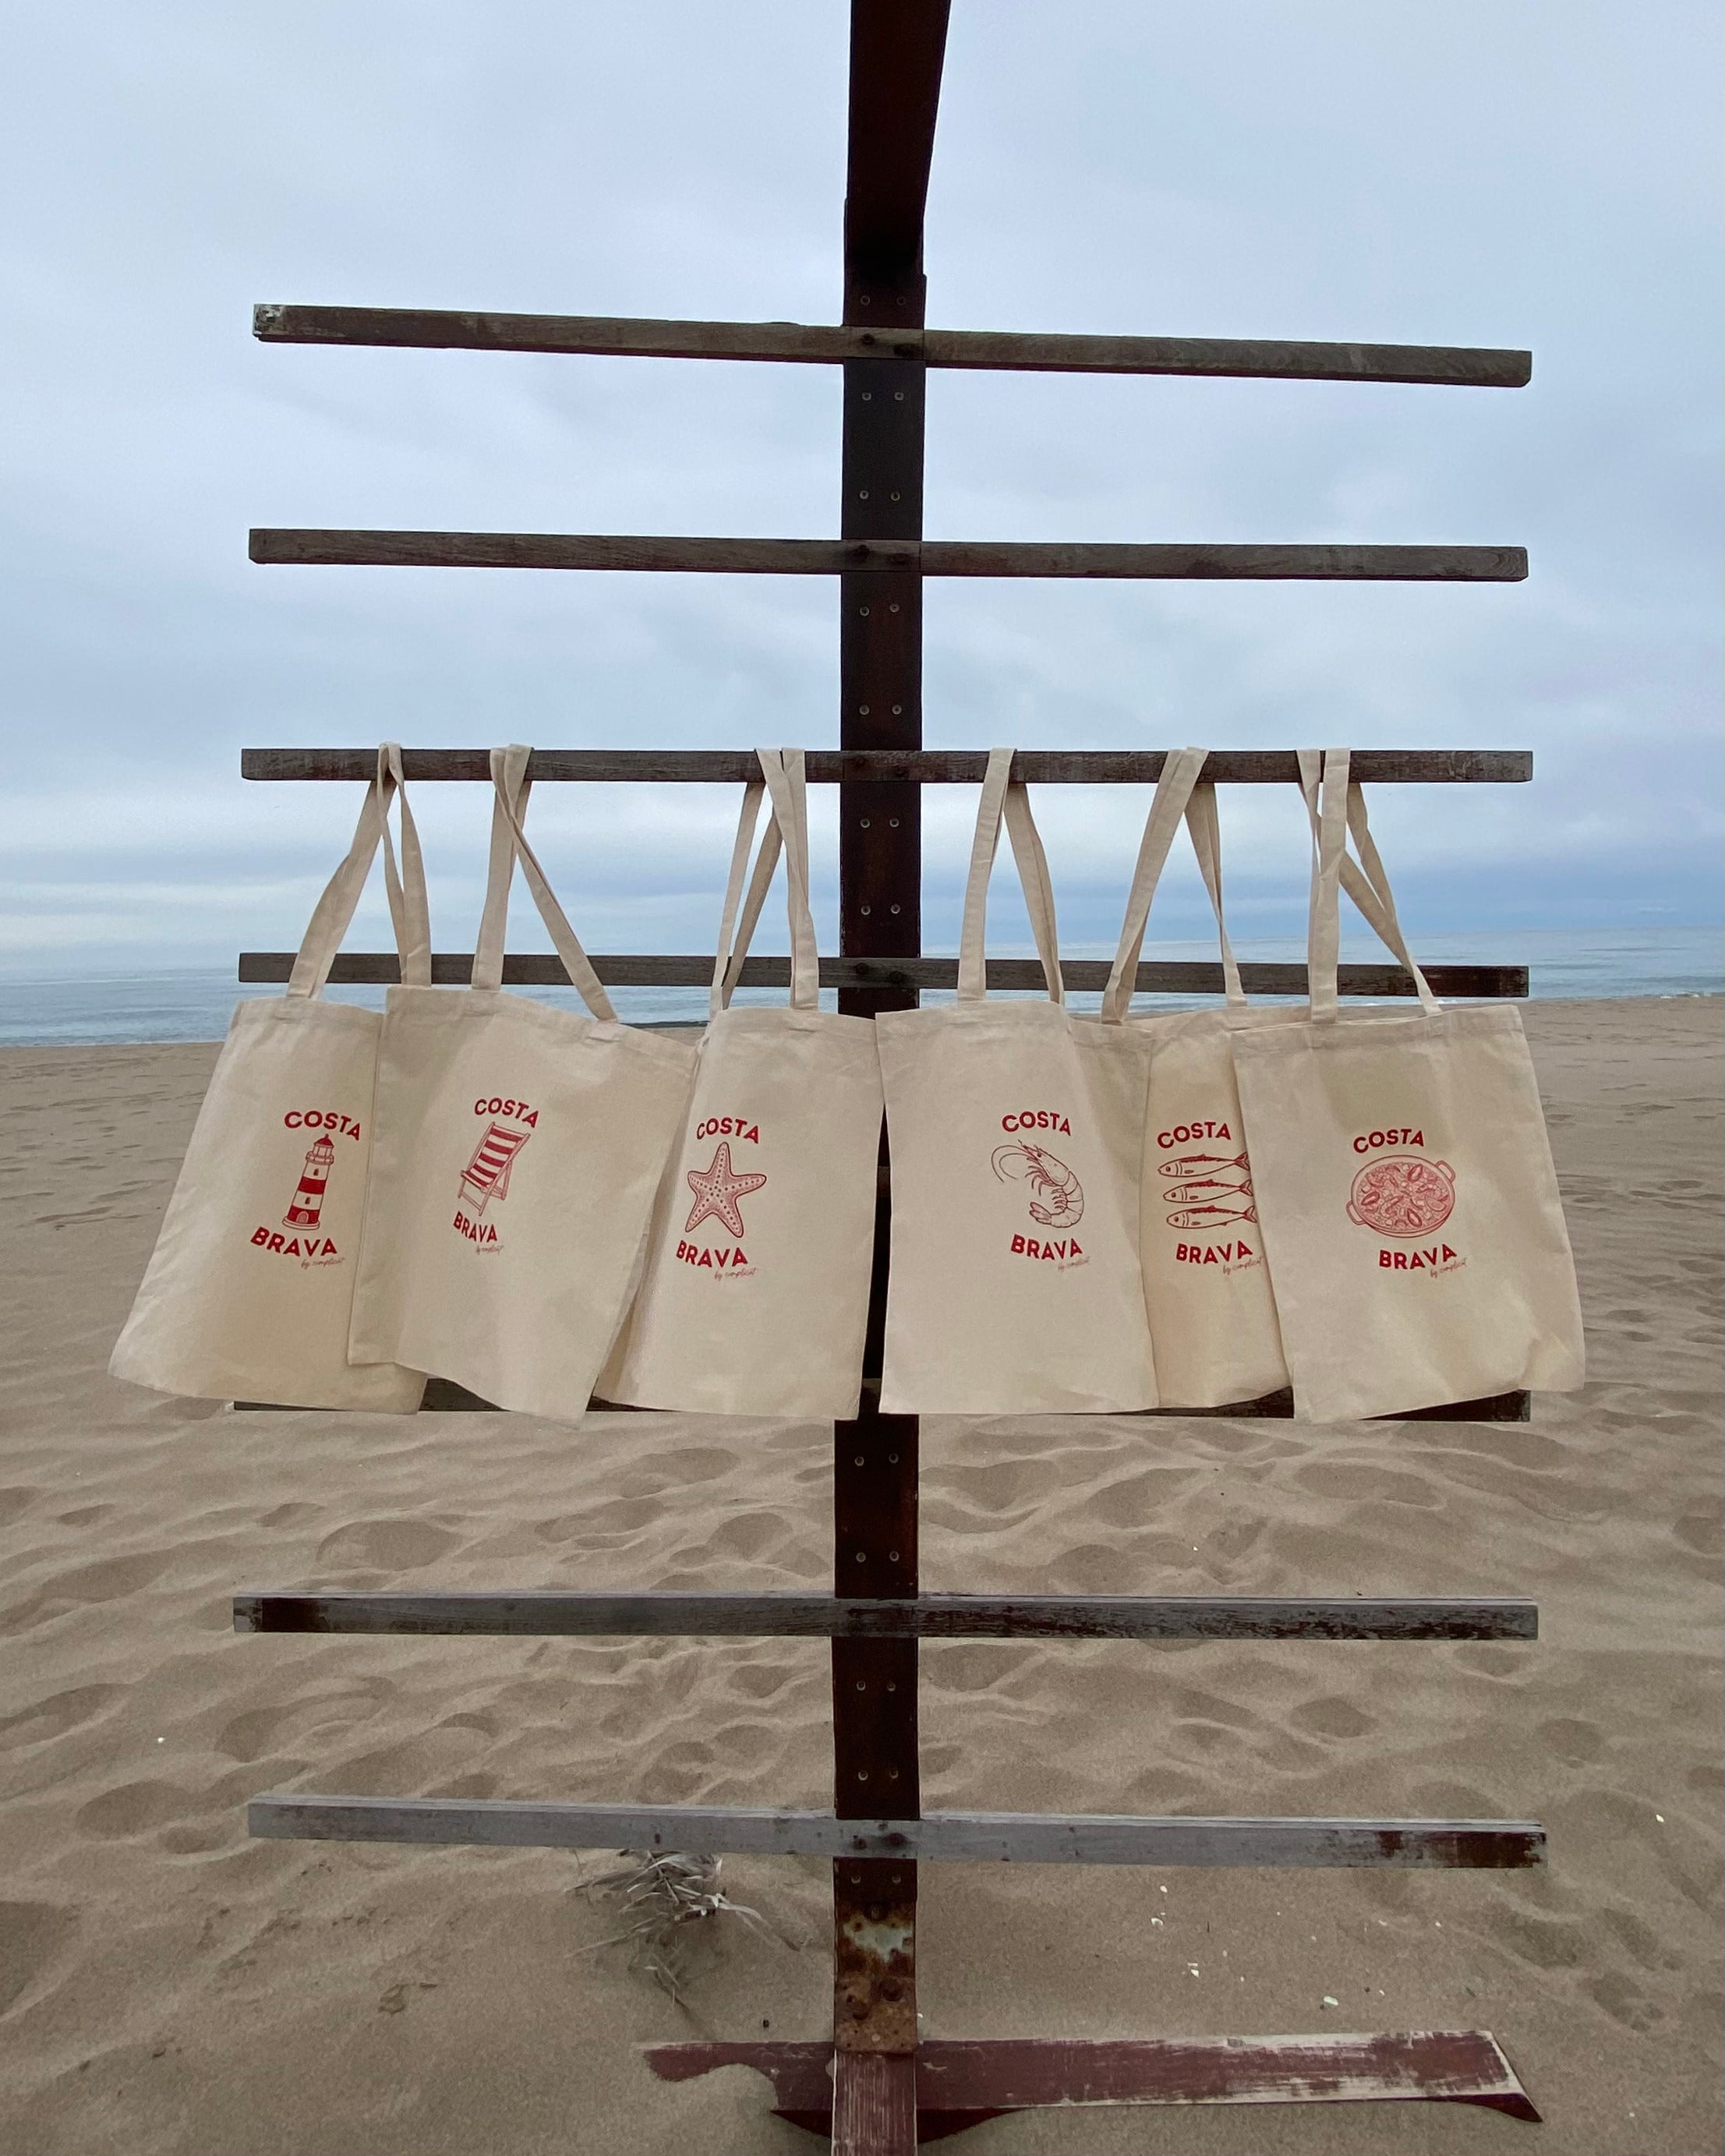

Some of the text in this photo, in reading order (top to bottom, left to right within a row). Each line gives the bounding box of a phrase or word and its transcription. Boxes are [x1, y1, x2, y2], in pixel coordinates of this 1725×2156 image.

[284, 1110, 360, 1141] COSTA
[474, 1097, 539, 1128] COSTA
[1002, 1111, 1071, 1136] COSTA
[696, 1116, 760, 1143] COSTA
[1157, 1121, 1231, 1148] COSTA
[1353, 1128, 1425, 1154] COSTA
[453, 1212, 498, 1242] BRAVA
[250, 1227, 337, 1256] BRAVA
[676, 1239, 748, 1267] BRAVA
[1010, 1234, 1083, 1260] BRAVA
[1175, 1240, 1253, 1264] BRAVA
[300, 1258, 310, 1271] by
[1222, 1264, 1232, 1275] by
[1378, 1243, 1457, 1270] BRAVA
[1430, 1267, 1438, 1278] by
